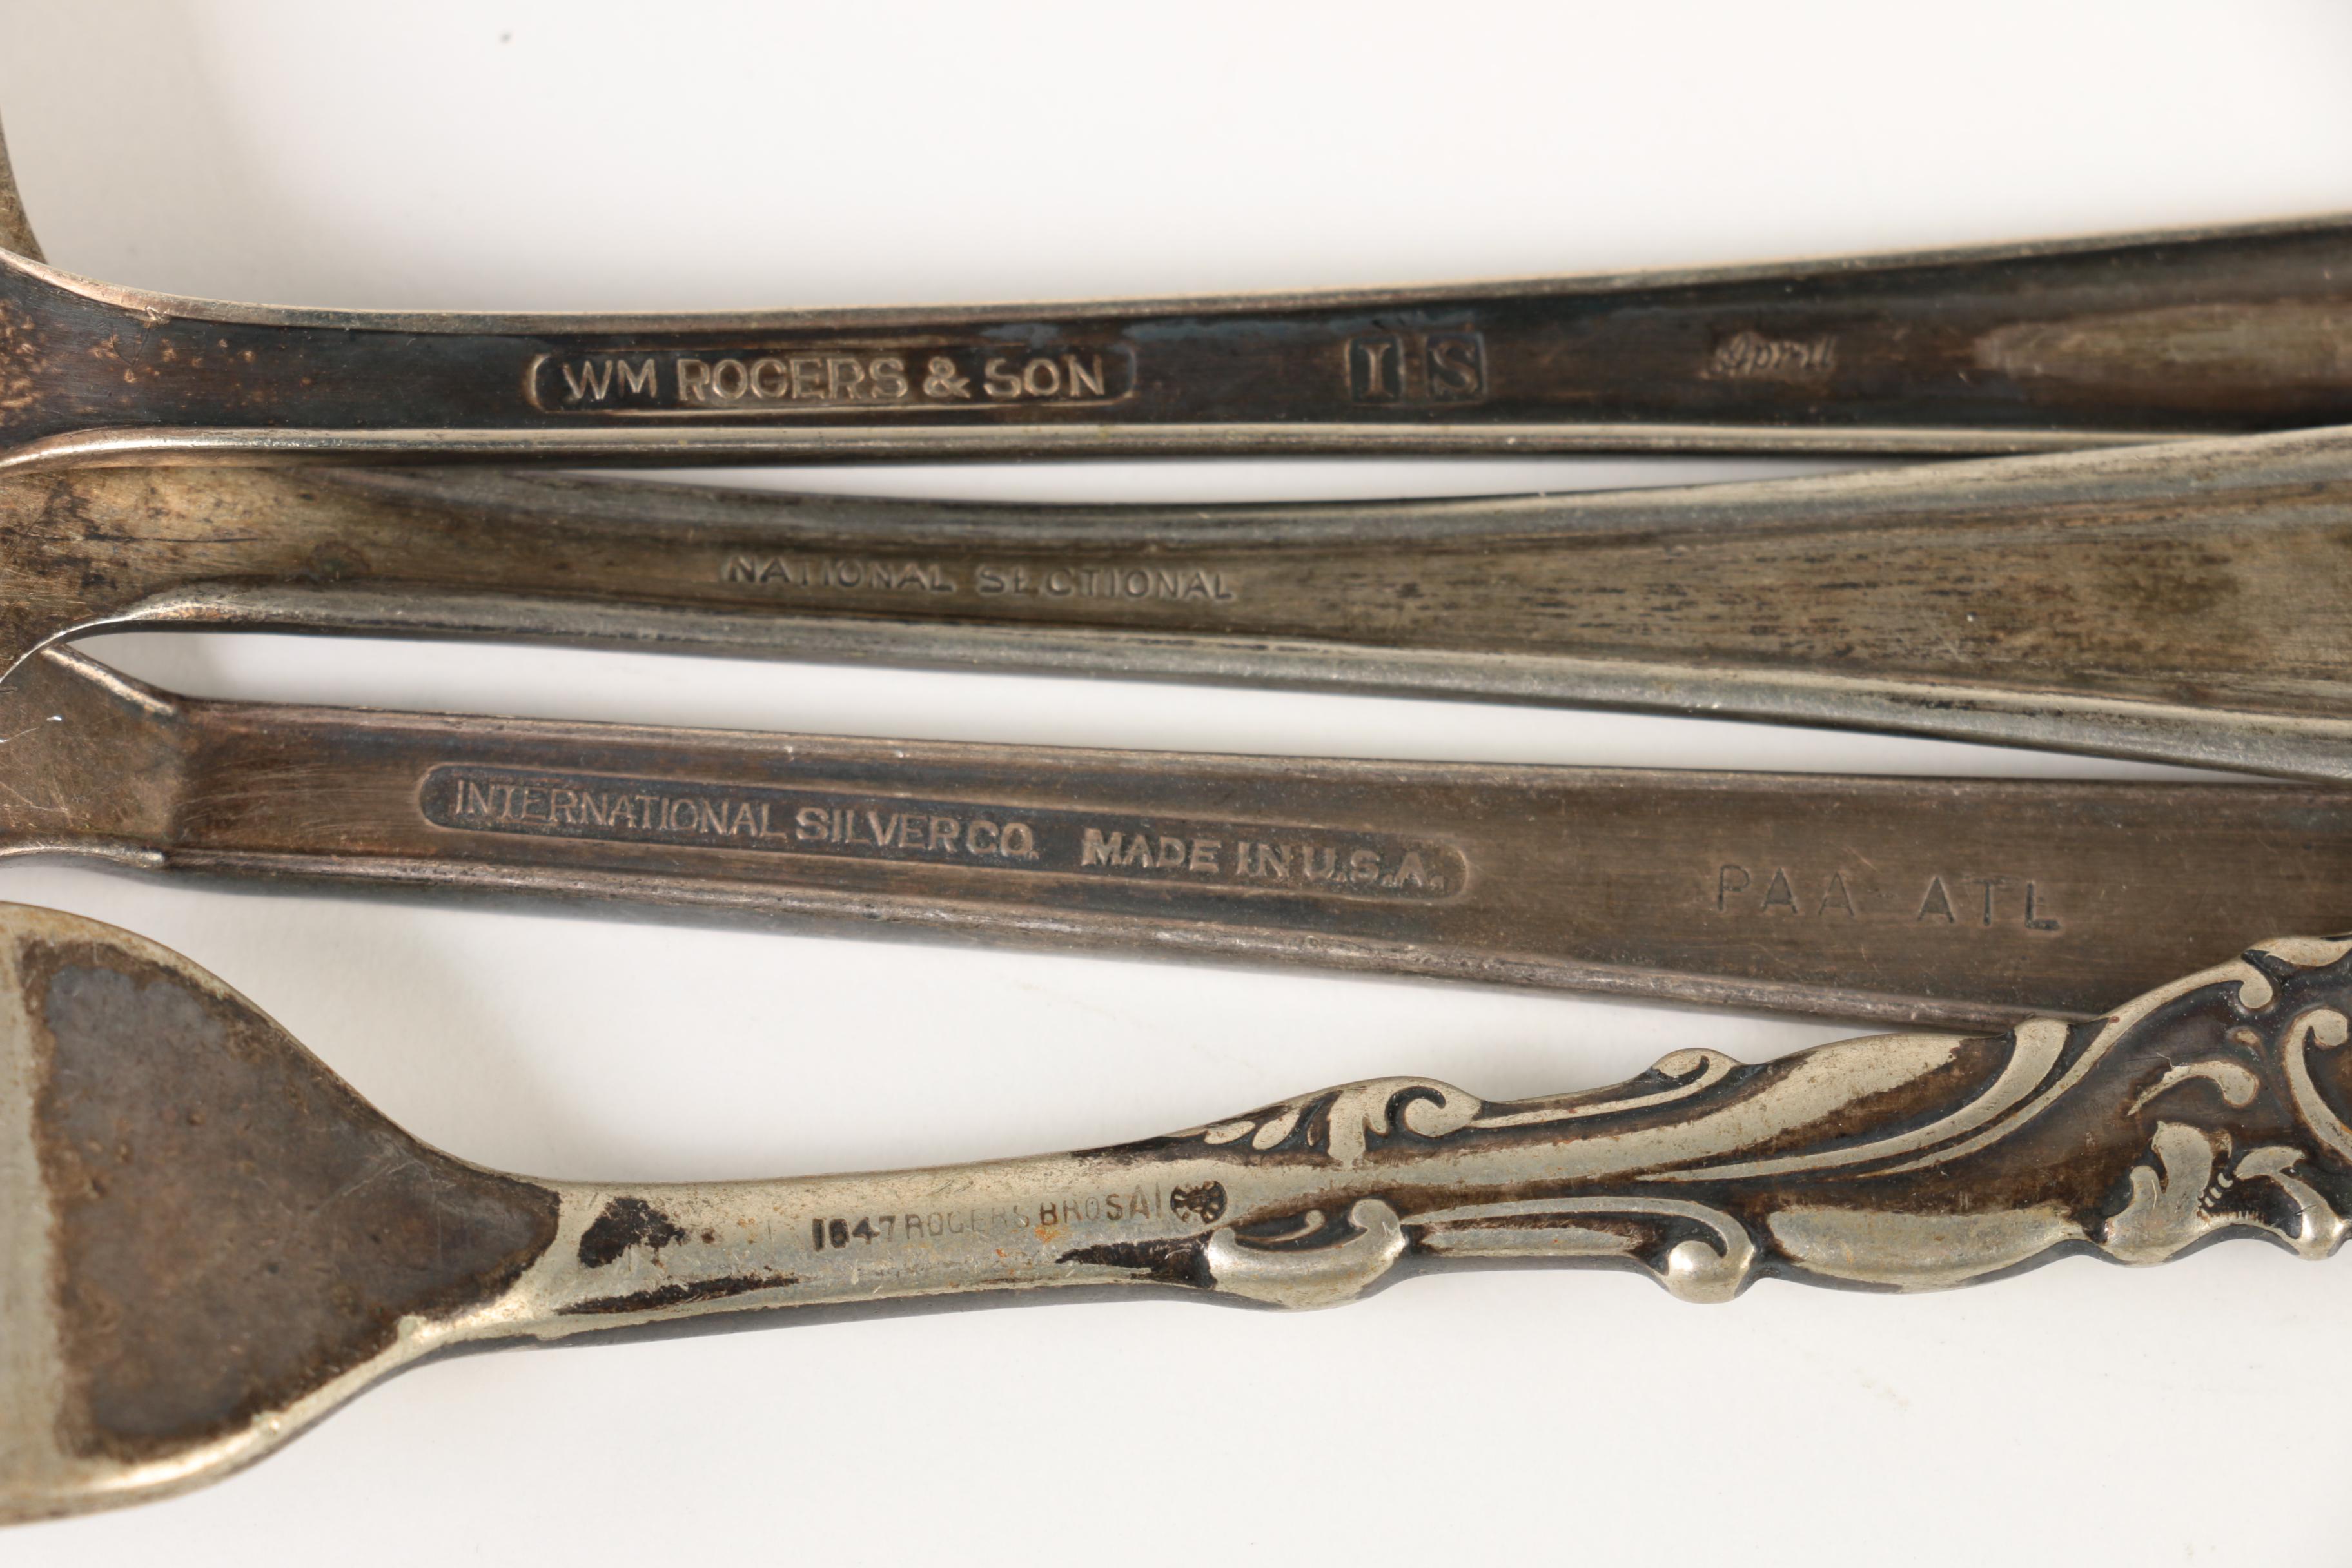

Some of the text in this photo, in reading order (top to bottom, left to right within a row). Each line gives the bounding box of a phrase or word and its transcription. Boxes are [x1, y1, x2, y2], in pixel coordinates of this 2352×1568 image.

[562, 353, 1105, 402] WM ROGERS & SON
[722, 556, 1236, 602] NATIONAL SECTIONAL
[453, 778, 786, 839] INTERNATIONAL
[795, 806, 958, 854] SILVER
[1080, 827, 1220, 874] MADE
[1235, 841, 1291, 879] IN
[1718, 864, 2061, 931] PAA ATL
